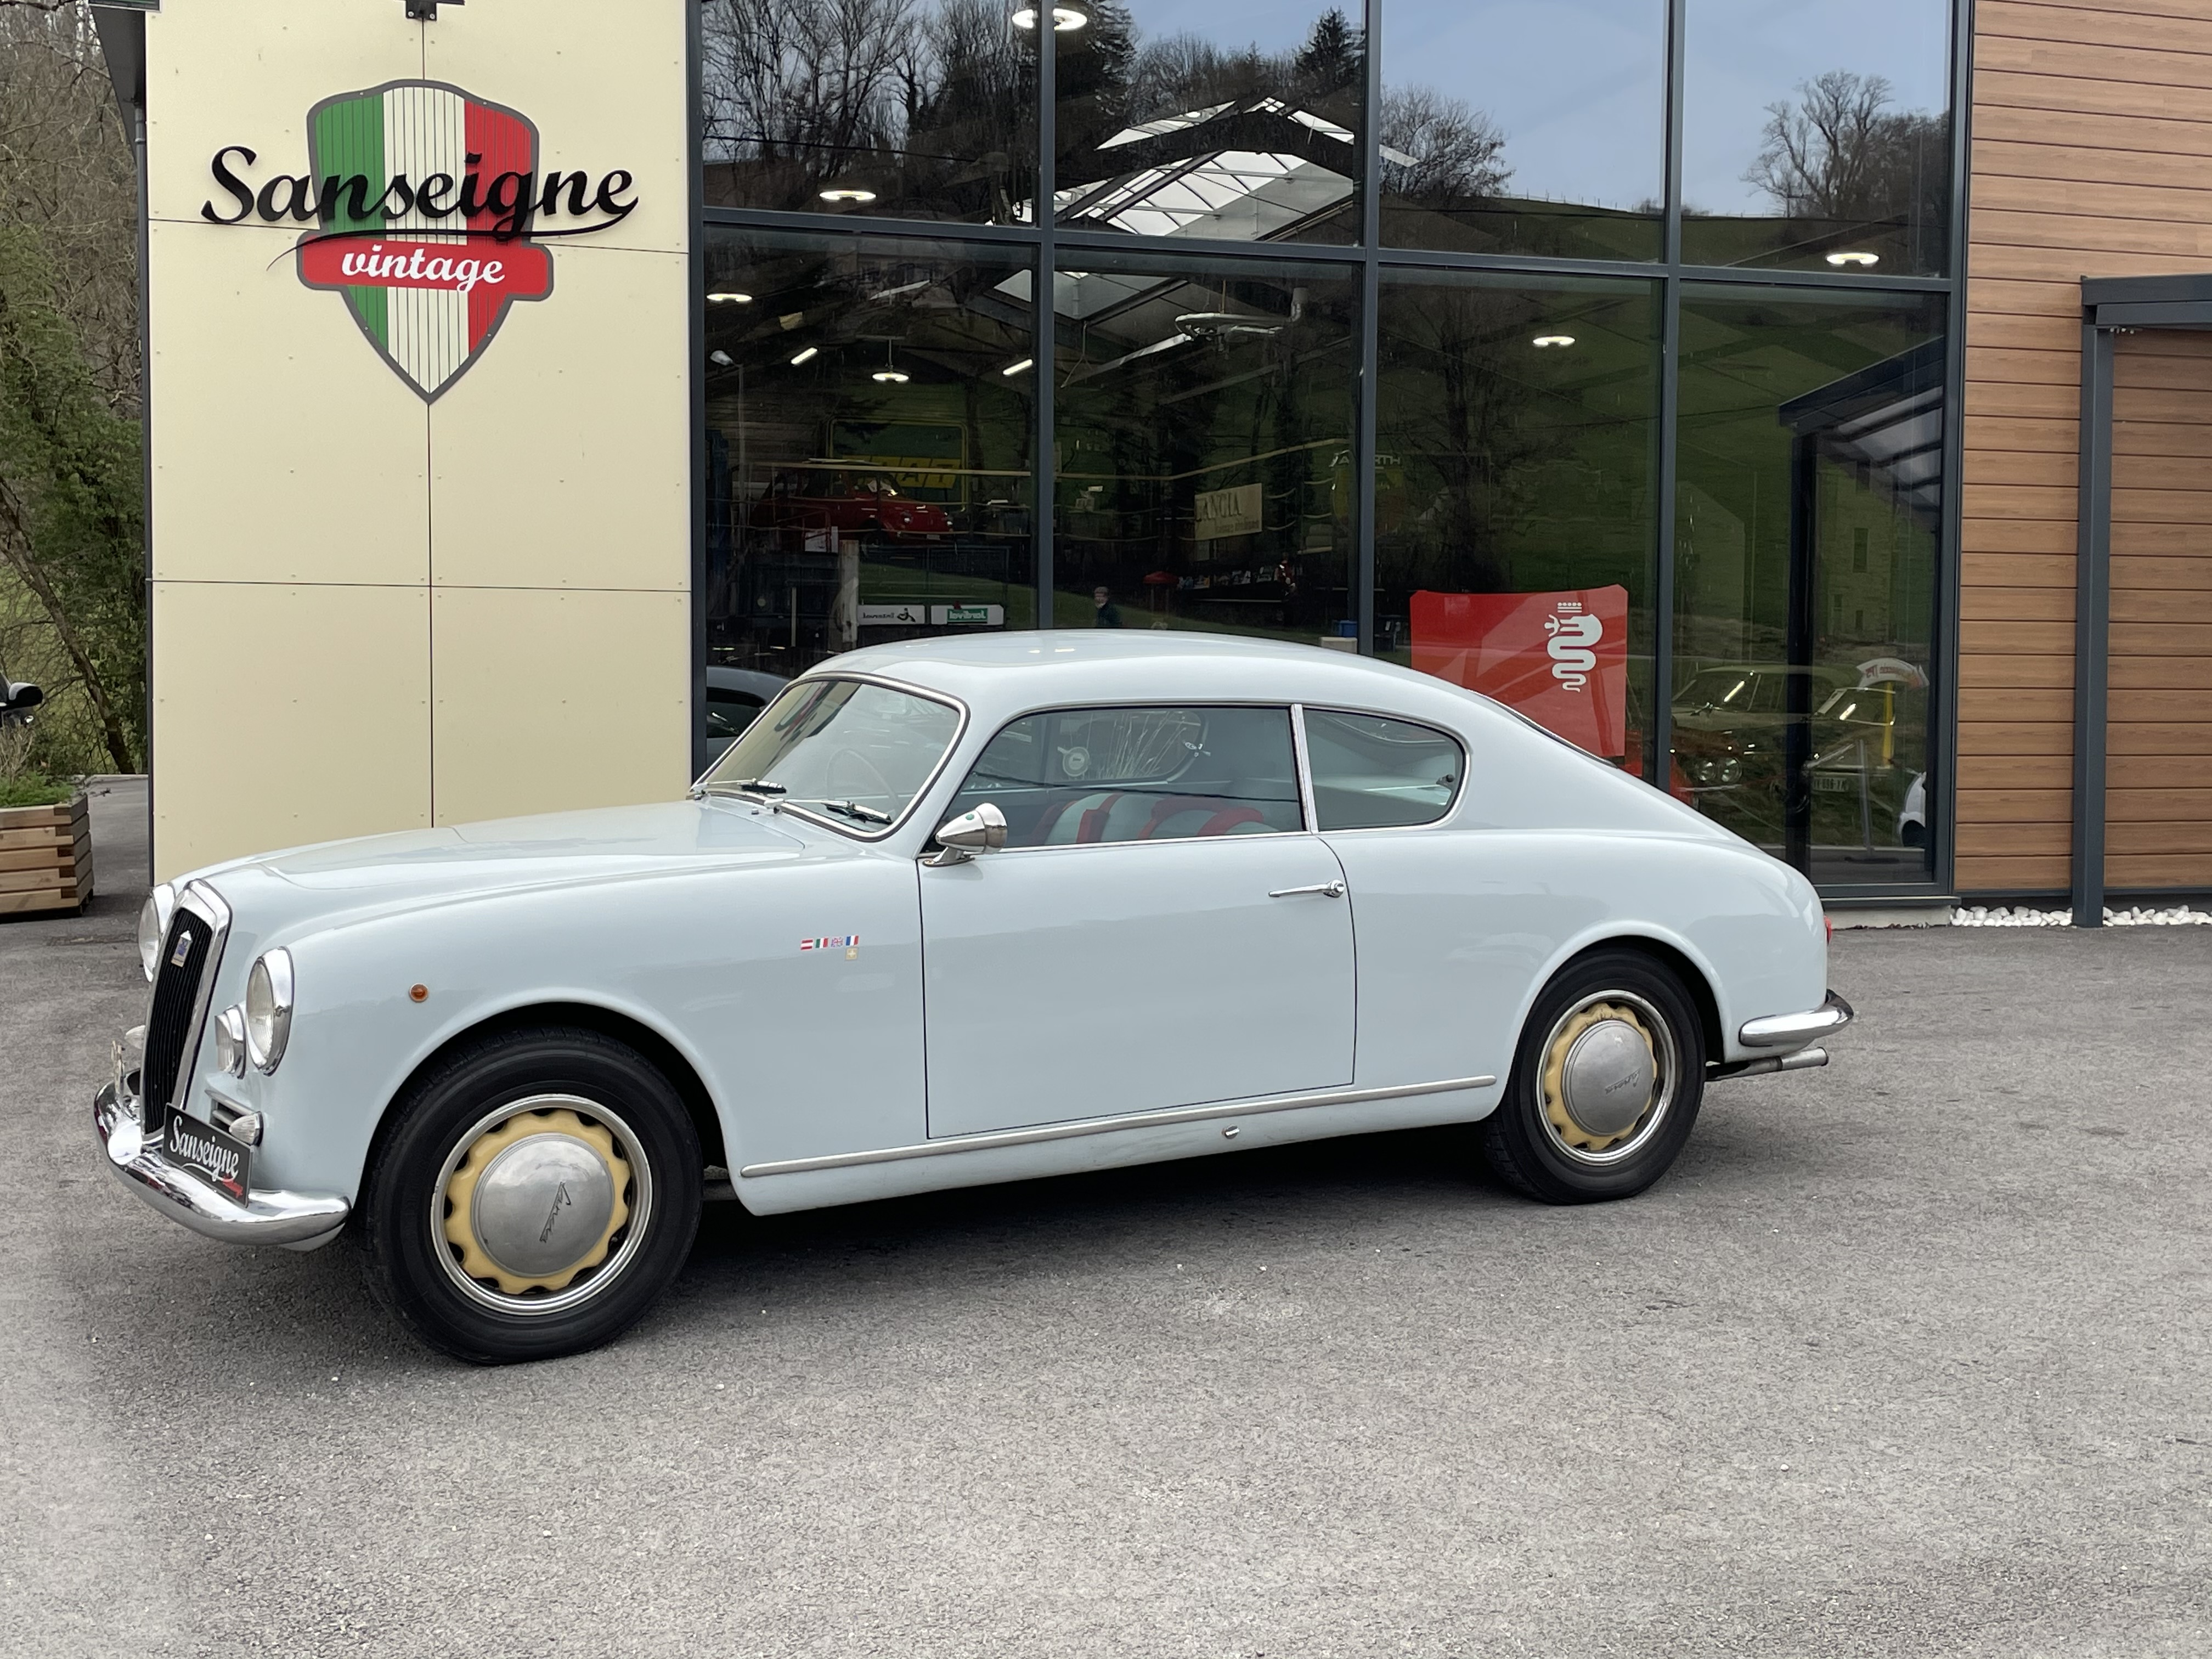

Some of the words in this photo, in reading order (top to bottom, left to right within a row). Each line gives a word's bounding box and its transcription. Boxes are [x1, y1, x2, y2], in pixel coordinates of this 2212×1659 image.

[201, 146, 638, 240] Sanseigne
[341, 244, 505, 292] vintage
[170, 1115, 239, 1182] Sanseigne
